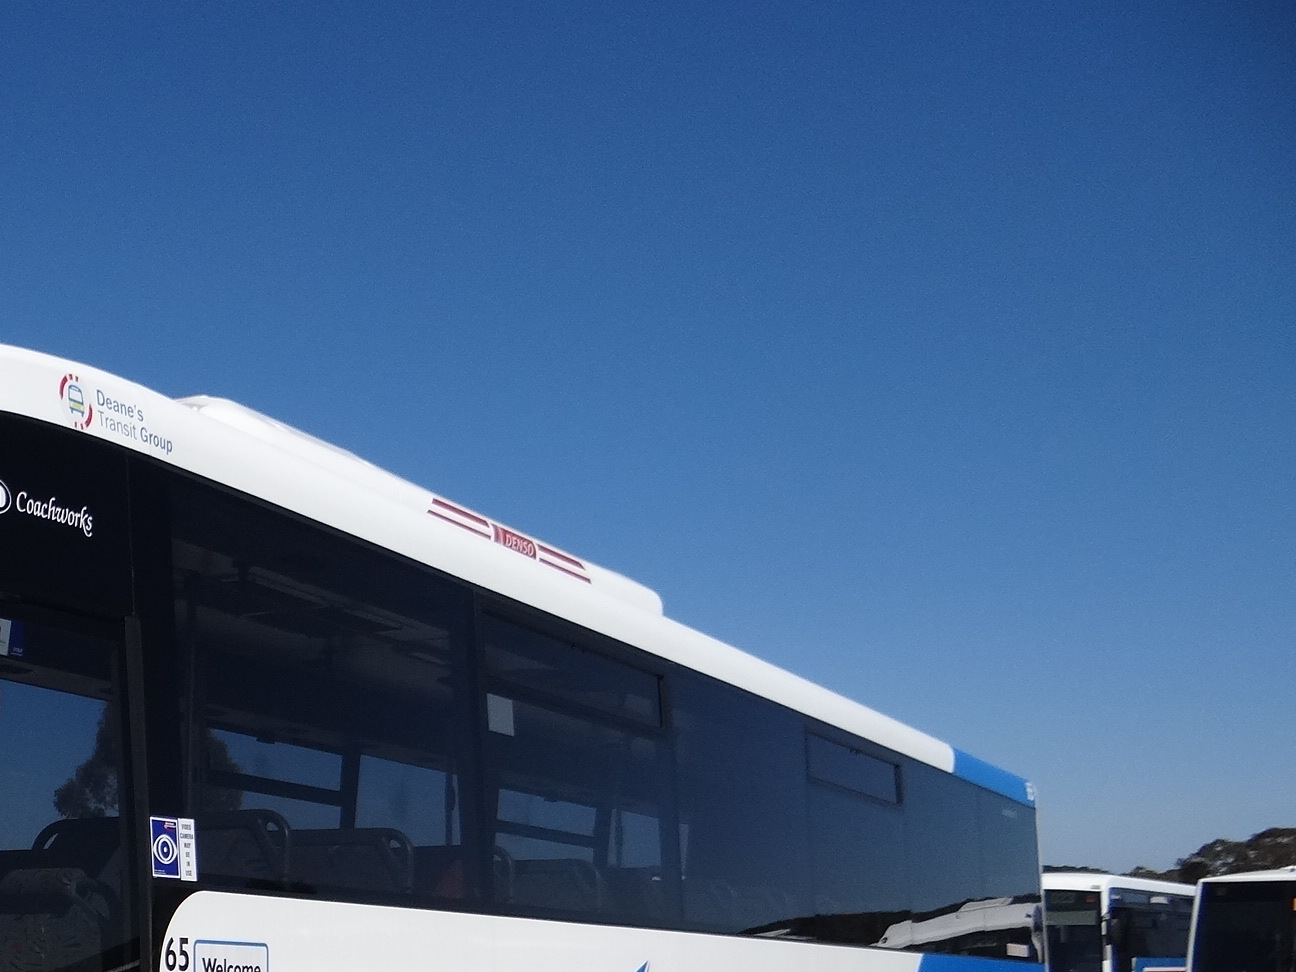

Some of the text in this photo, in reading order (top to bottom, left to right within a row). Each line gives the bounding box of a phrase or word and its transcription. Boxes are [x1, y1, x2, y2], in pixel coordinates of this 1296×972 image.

[96, 389, 144, 422] Deane's
[98, 410, 173, 455] Transit Group
[16, 491, 93, 537] Coachworks
[505, 533, 535, 557] DENSO
[164, 937, 190, 971] 65
